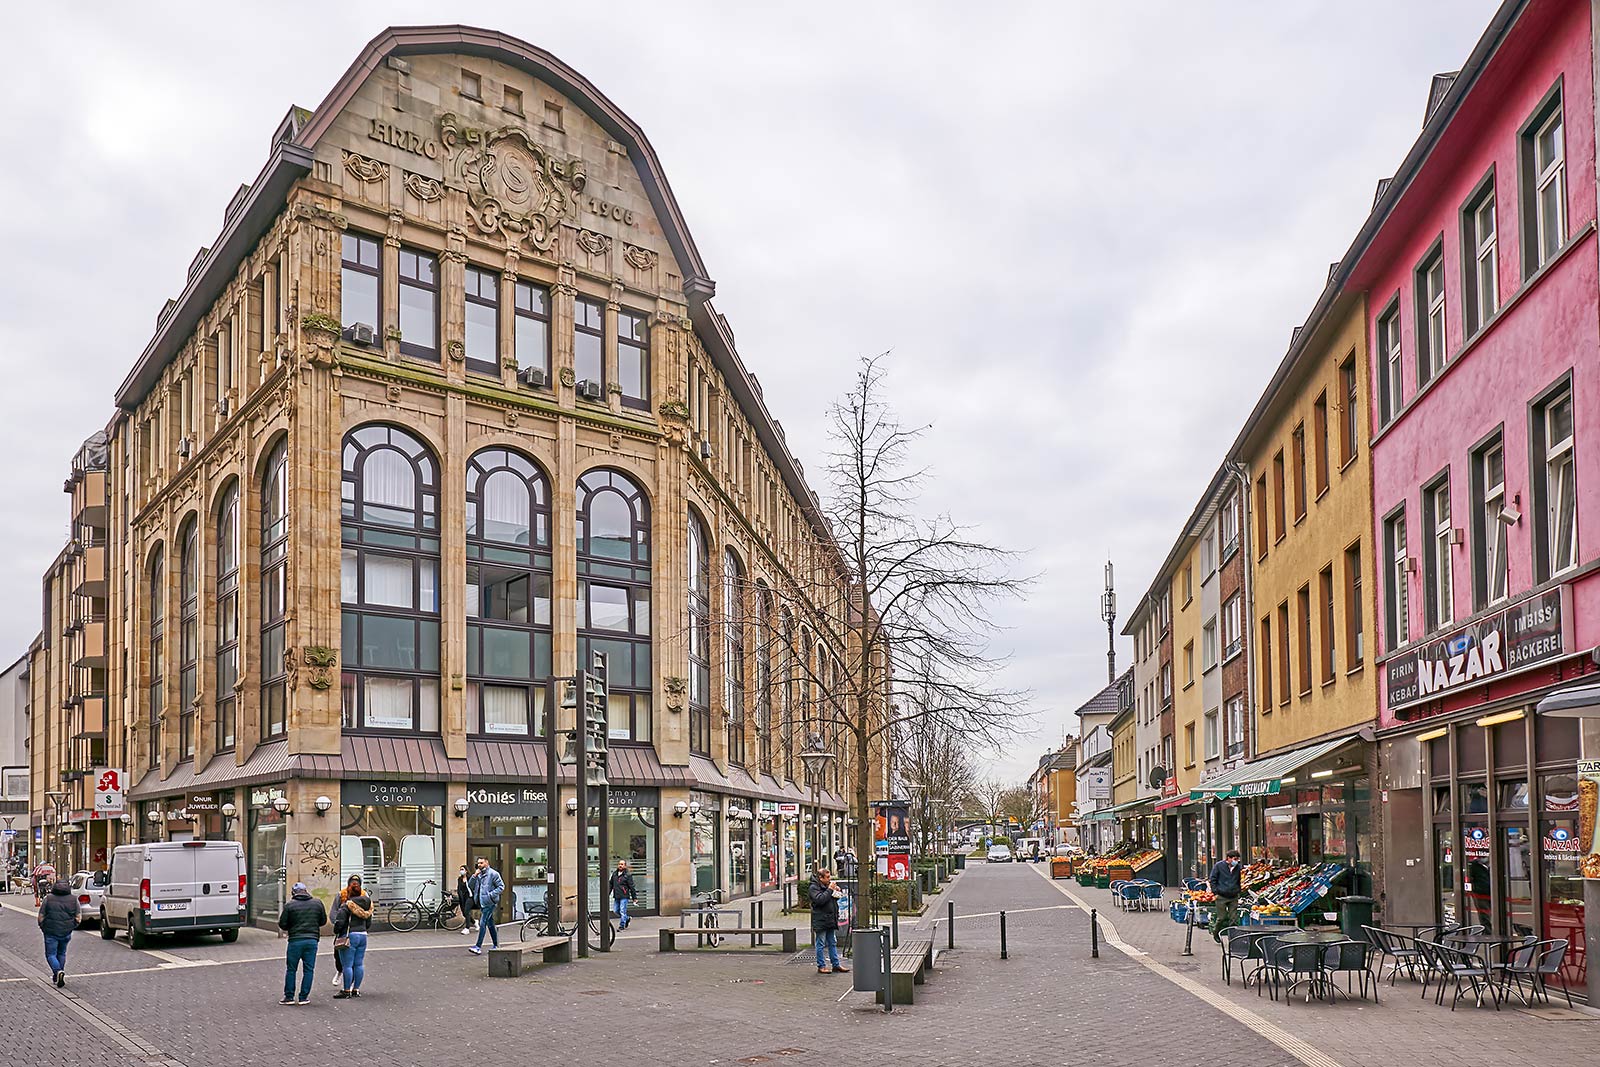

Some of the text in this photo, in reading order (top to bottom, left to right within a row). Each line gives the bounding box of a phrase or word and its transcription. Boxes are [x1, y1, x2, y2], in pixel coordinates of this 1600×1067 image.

[588, 198, 635, 226] 1906
[1514, 605, 1552, 633] IMBISS
[1391, 661, 1414, 681] FIRIN
[1418, 630, 1503, 696] NAZAR
[1389, 685, 1417, 704] KEBAP
[370, 784, 417, 793] Damen
[375, 794, 412, 802] salon
[608, 797, 633, 805] alon
[1543, 837, 1580, 851] NAZAR
